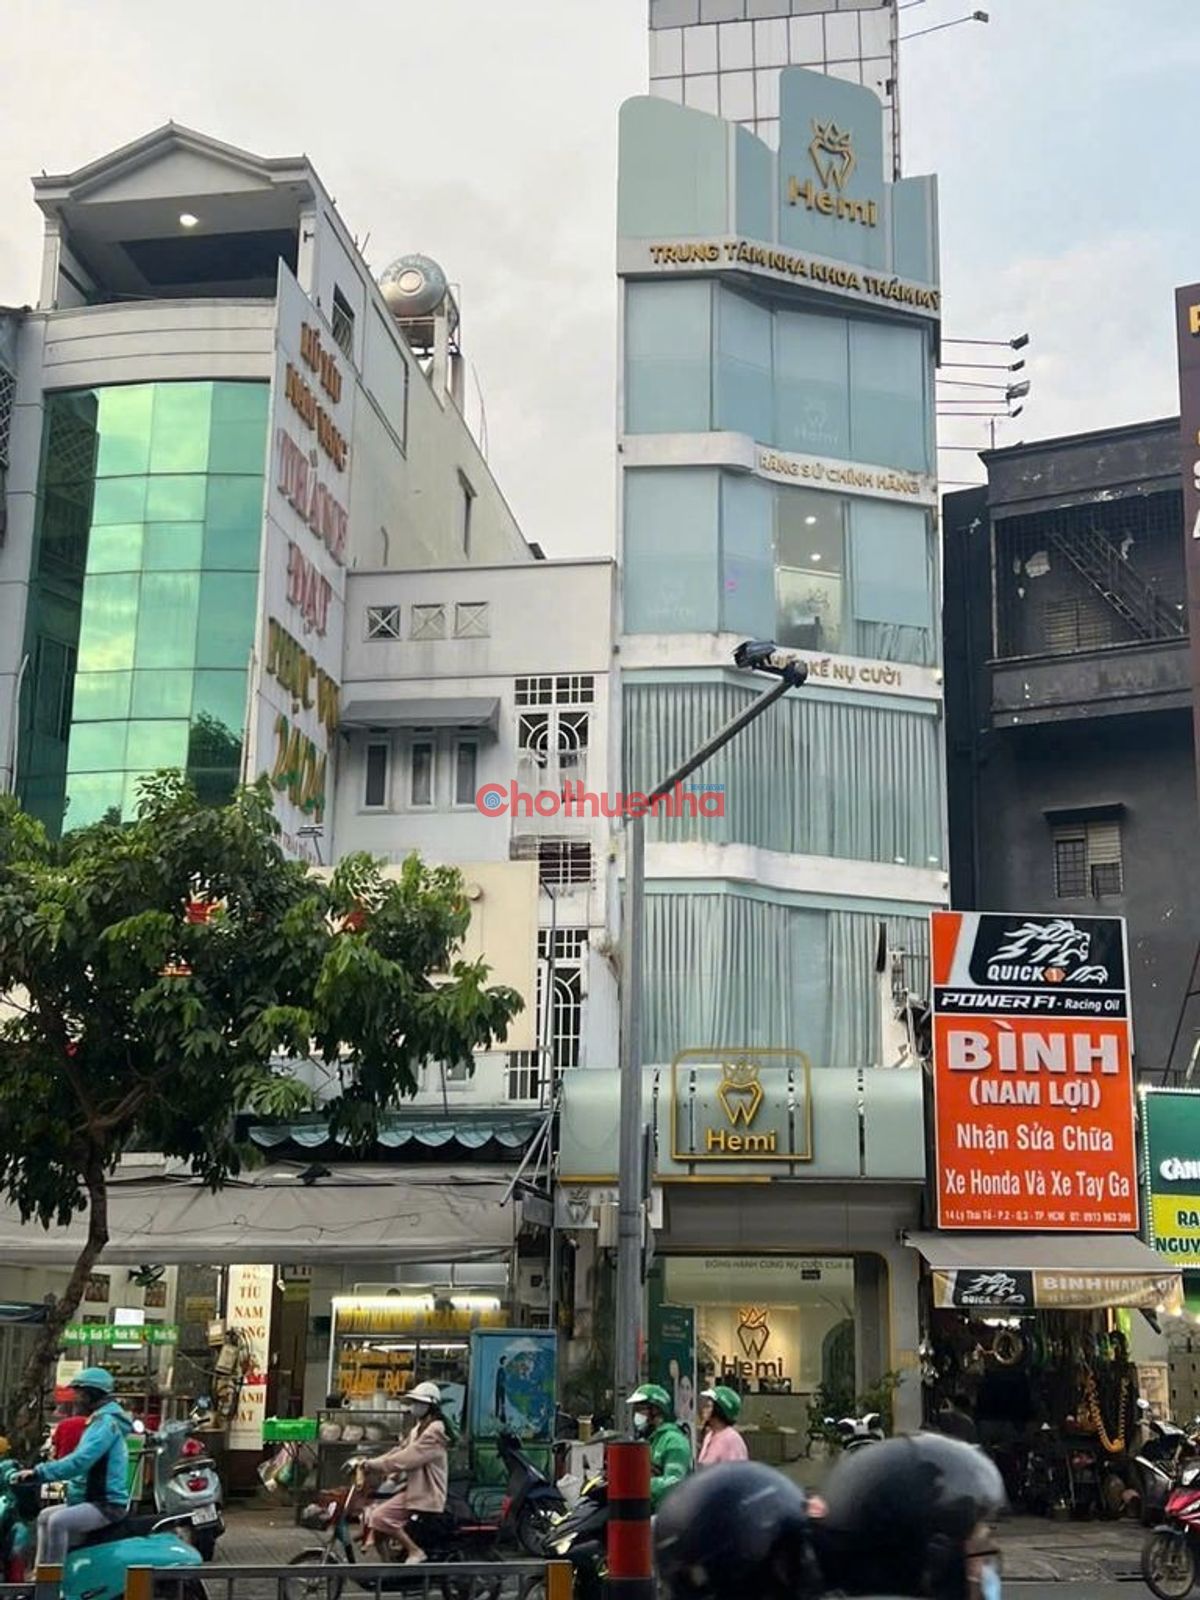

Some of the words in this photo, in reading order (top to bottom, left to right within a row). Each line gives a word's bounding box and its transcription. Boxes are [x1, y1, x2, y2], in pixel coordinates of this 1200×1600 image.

[788, 175, 878, 228] Hemi
[650, 244, 720, 265] TRUNG
[723, 240, 769, 267] TÂM
[768, 250, 808, 278] NHA
[810, 260, 861, 291] KHOA
[809, 657, 831, 678] KẾ
[833, 664, 856, 684] NỤ
[859, 665, 902, 687] CƯỜI
[987, 964, 1045, 982] QUICK
[941, 993, 1030, 1009] POWER
[1064, 998, 1102, 1012] Racing
[1104, 999, 1120, 1012] Oil
[947, 1019, 1120, 1075] BÌNH
[969, 1076, 1042, 1107] (NAM
[1049, 1078, 1101, 1114] LỢI)
[706, 1128, 777, 1152] Hemi
[956, 1122, 1009, 1155] Nhận
[1016, 1121, 1055, 1151] Sửa
[1062, 1125, 1114, 1152] Chữa
[944, 1168, 966, 1195] Xe
[970, 1168, 1021, 1196] Honda
[1024, 1169, 1046, 1196] Và
[1050, 1170, 1072, 1197] Xe
[1075, 1171, 1105, 1202] Tay
[1108, 1171, 1130, 1197] Ga
[234, 1306, 264, 1319] NAM
[721, 1355, 783, 1378] Hemi
